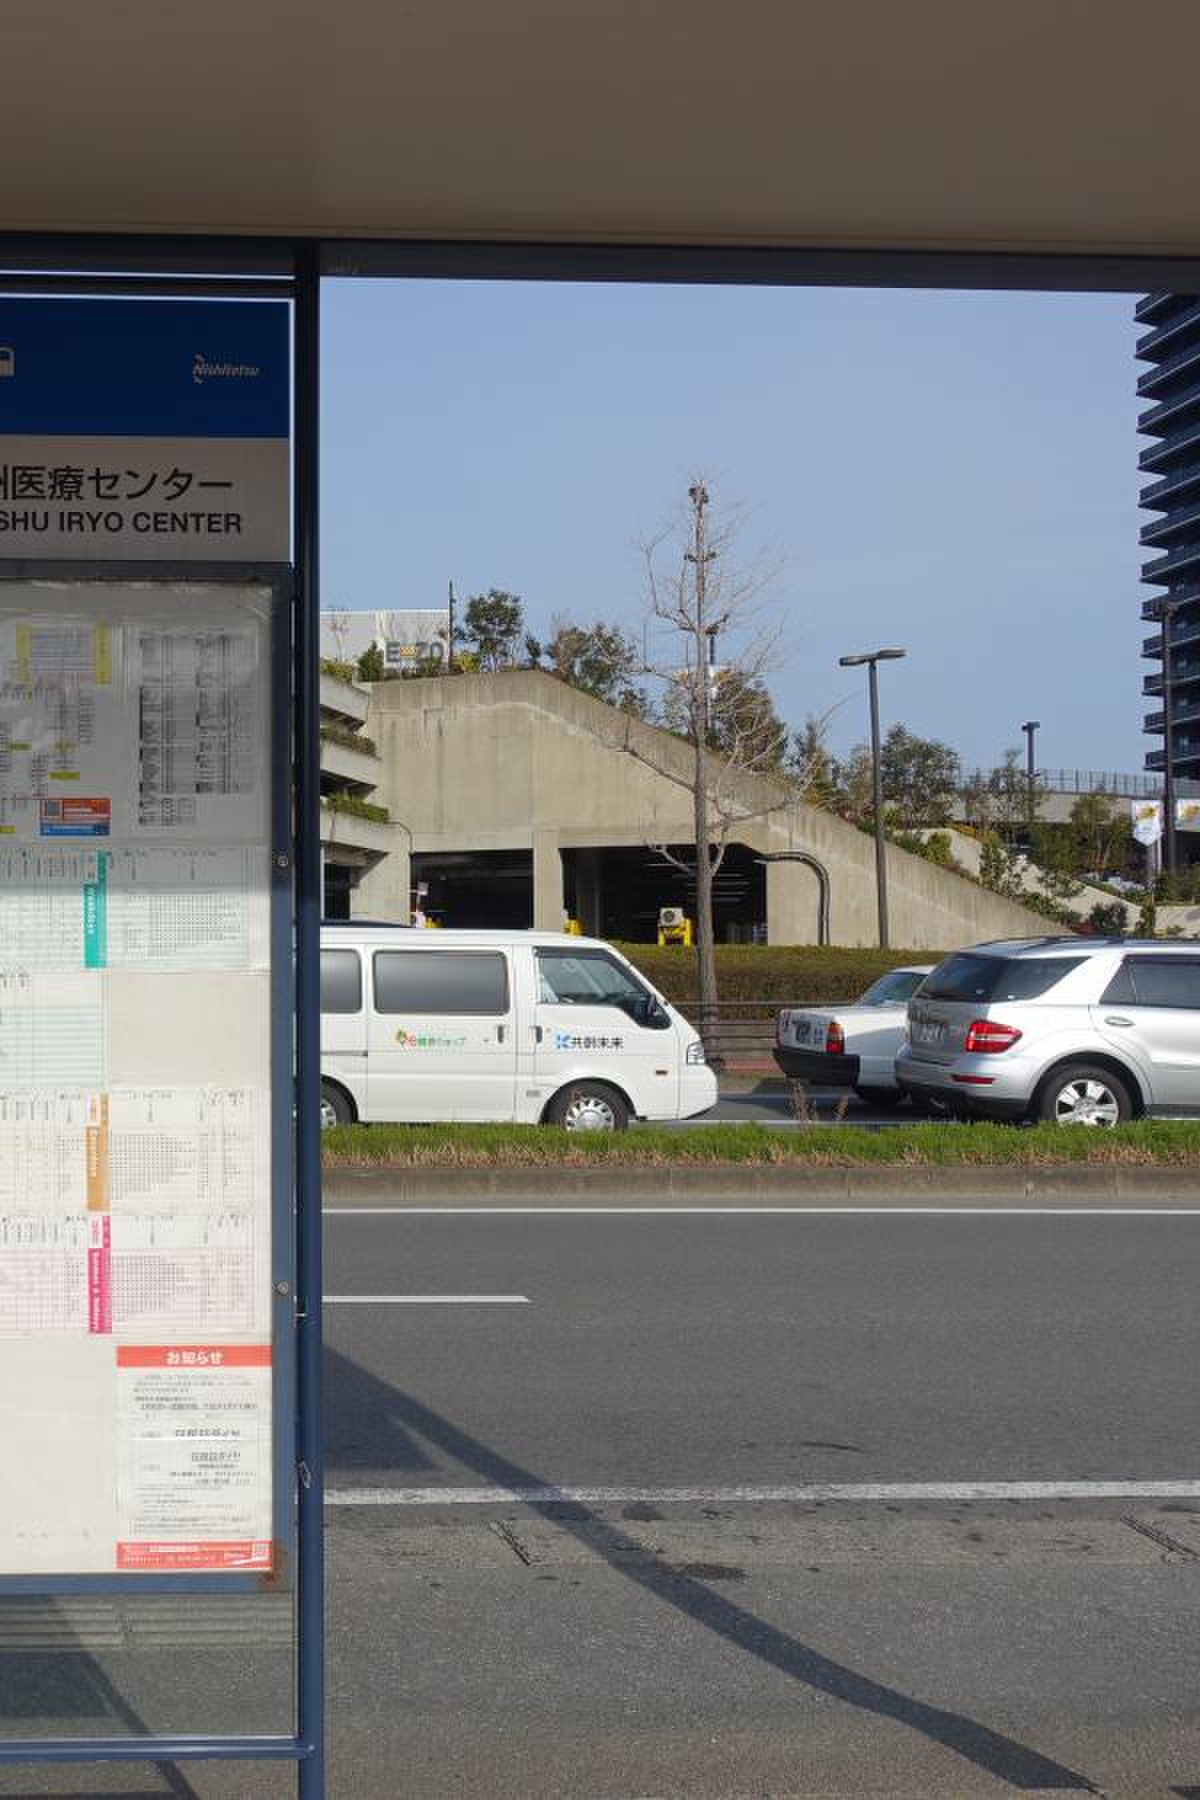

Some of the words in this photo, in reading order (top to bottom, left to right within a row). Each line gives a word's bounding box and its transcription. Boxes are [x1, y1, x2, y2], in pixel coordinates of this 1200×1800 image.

[192, 354, 259, 384] Nishitetsu
[59, 510, 124, 533] IRYO
[132, 511, 242, 534] CENTER
[166, 1351, 223, 1365] お知らせ
